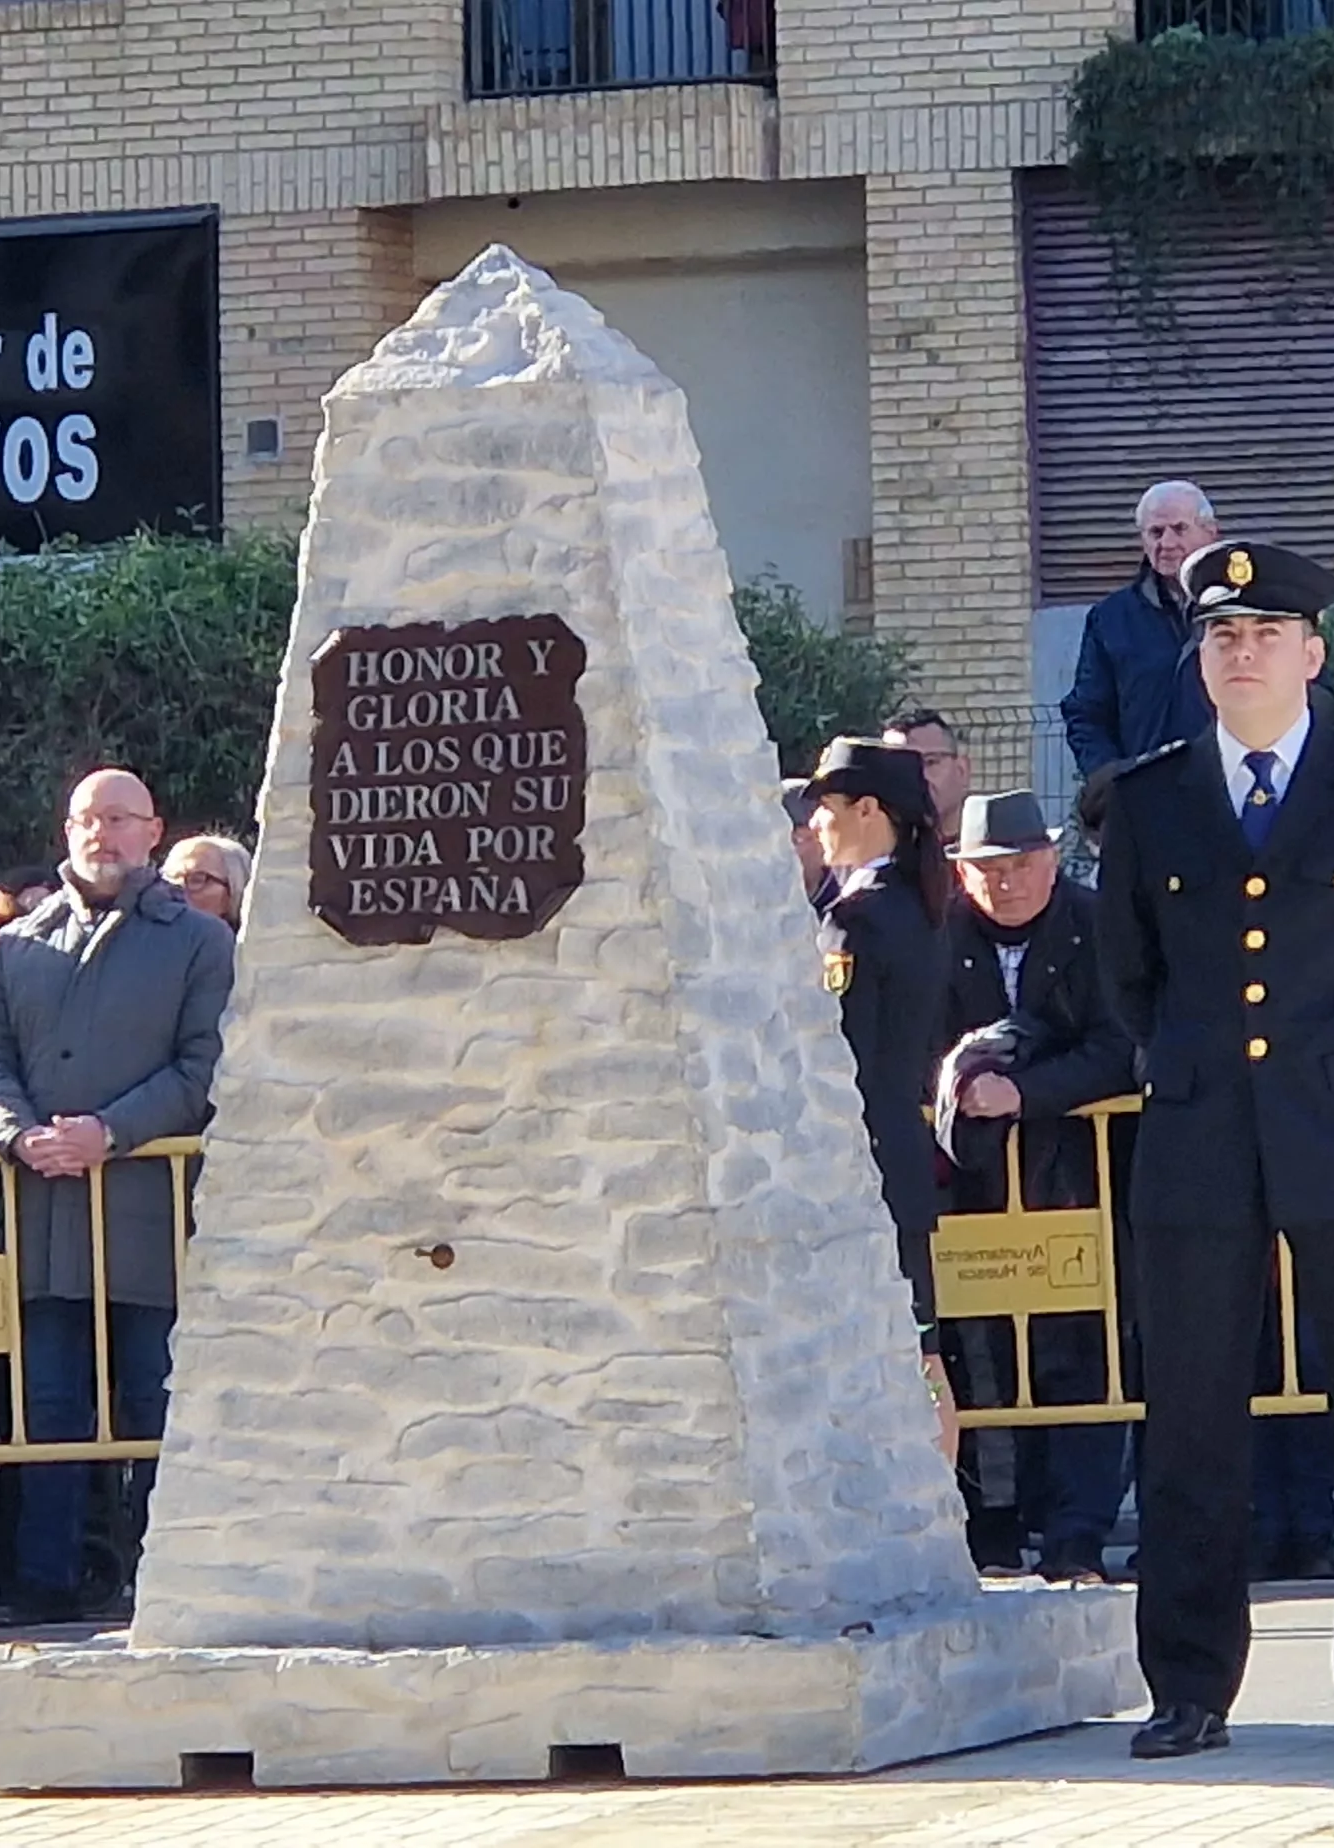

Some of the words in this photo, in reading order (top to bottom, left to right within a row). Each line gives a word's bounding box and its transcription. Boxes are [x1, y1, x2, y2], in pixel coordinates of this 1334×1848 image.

[26, 312, 96, 393] de
[346, 642, 504, 687] HONOR
[527, 639, 556, 677] Y
[347, 686, 521, 731] GLORIA
[328, 741, 359, 777] A
[374, 736, 461, 777] LOS
[472, 730, 568, 774] QUE
[328, 780, 491, 824] DIERON
[512, 776, 572, 813] SU
[328, 829, 443, 870] VIDA
[467, 825, 556, 864] POR
[349, 866, 530, 915] ESPAÑA
